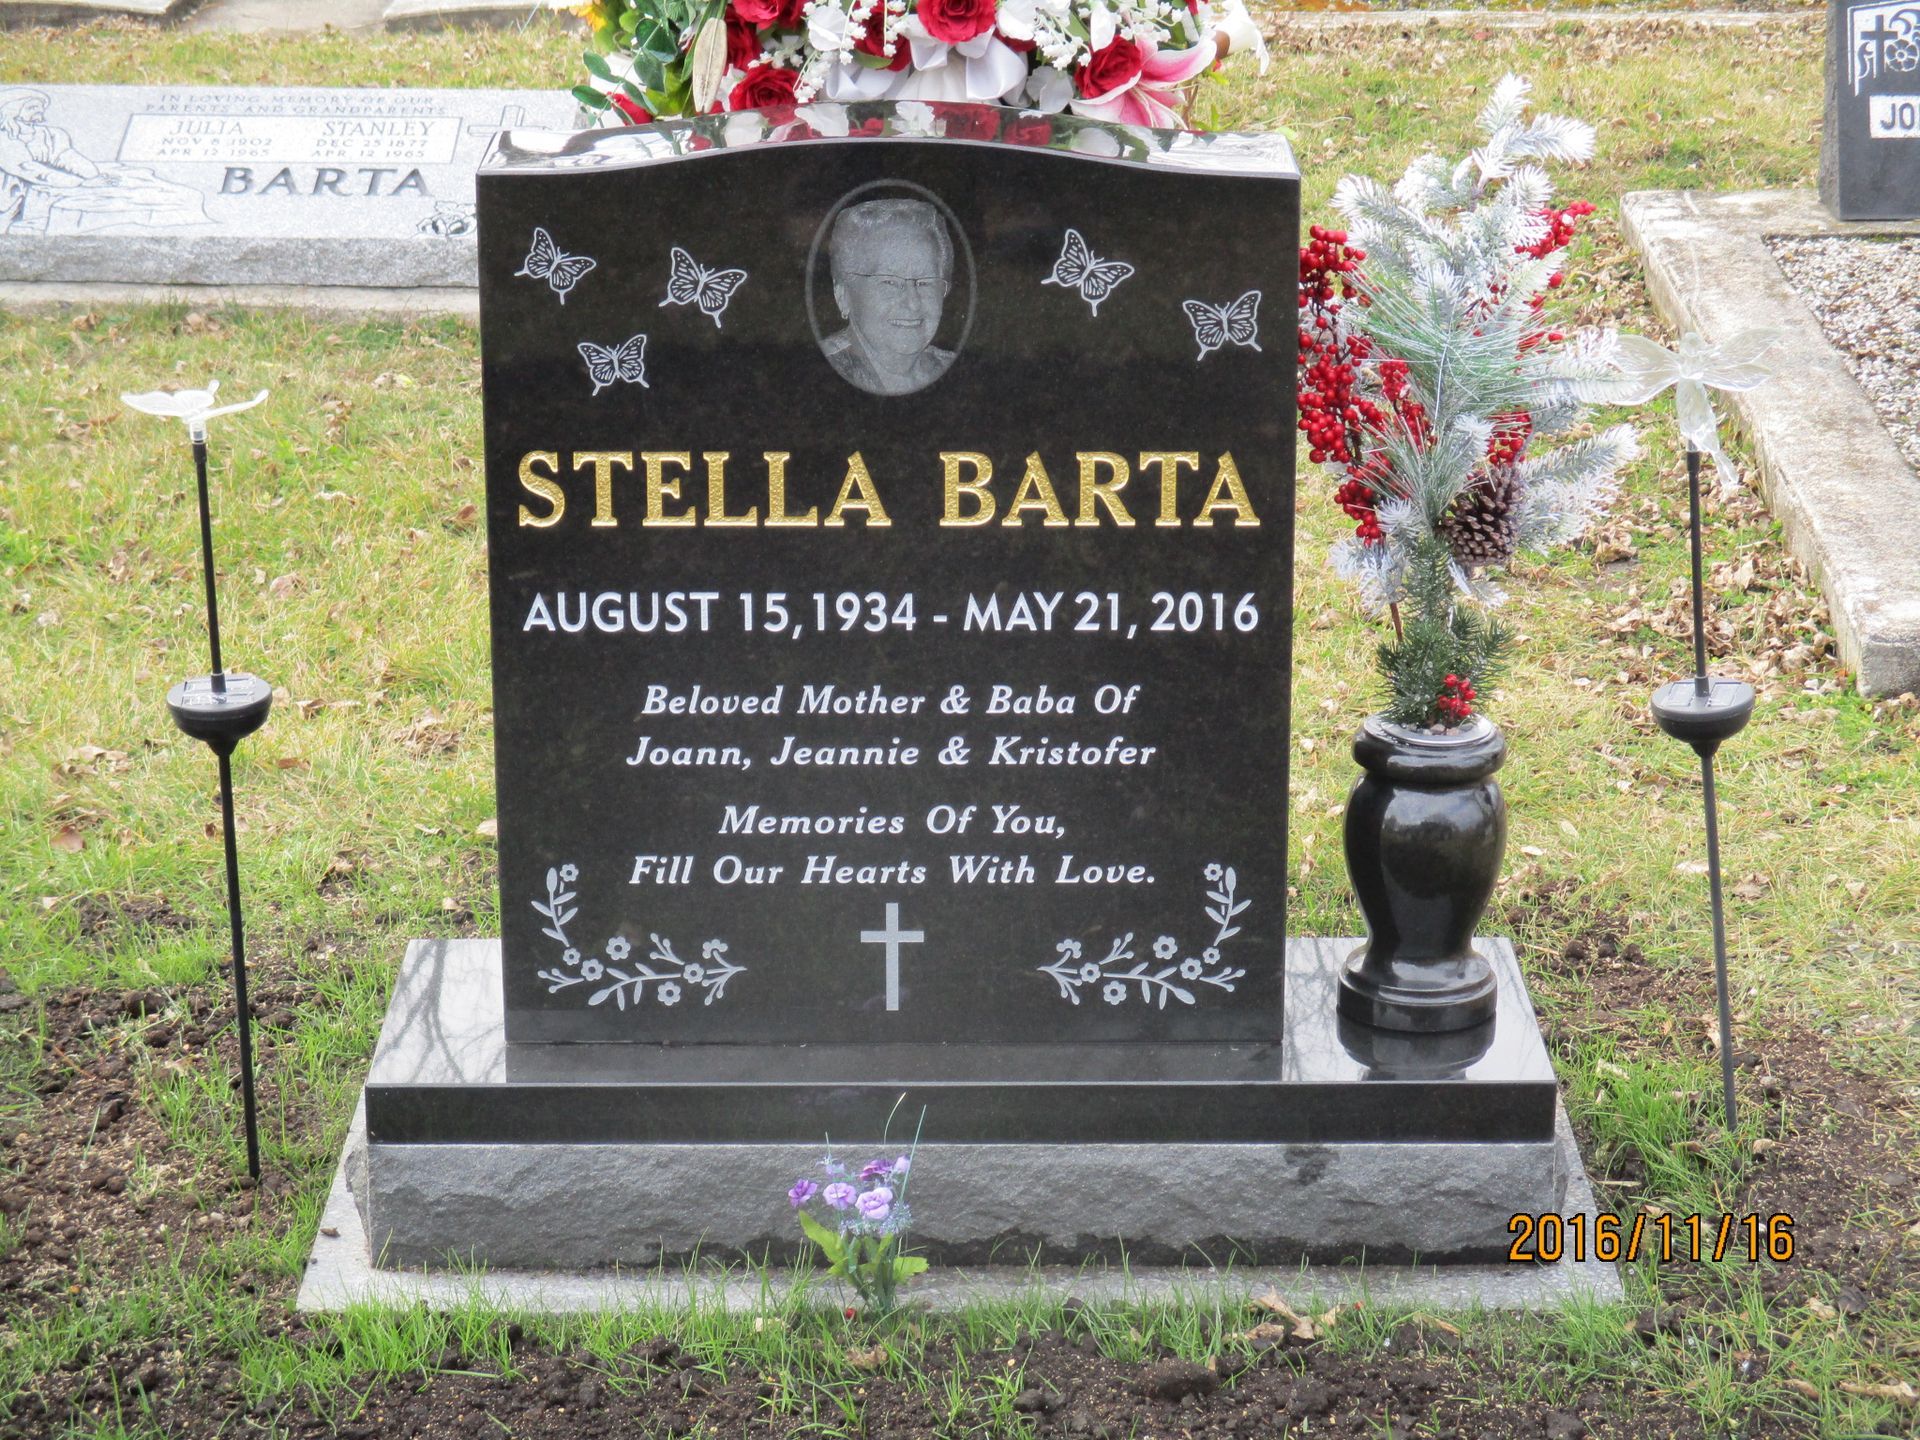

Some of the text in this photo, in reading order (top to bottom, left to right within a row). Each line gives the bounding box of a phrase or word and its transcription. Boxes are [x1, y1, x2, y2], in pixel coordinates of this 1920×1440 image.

[145, 104, 446, 115] PARENTS AND GRANDPARENTS
[160, 94, 434, 105] IN LOVING MEMORY OF OUR
[168, 120, 244, 135] JULIA
[1880, 102, 1920, 131] JO
[322, 121, 436, 137] STANLEY
[156, 148, 191, 156] APR
[161, 137, 202, 146] NOV
[316, 138, 429, 147] DEC 25 1877
[311, 150, 347, 158] APR
[217, 166, 436, 197] BARTA
[518, 450, 1261, 529] STELLA BARTA
[522, 591, 720, 633] AUGUST
[932, 614, 948, 624] -
[963, 591, 1065, 633] MAY
[1073, 591, 1138, 640] 21,
[1149, 591, 1260, 633] 2016
[640, 683, 1142, 715] Beloved Mother & Baba Of
[625, 735, 1157, 771] Joann, Jeannie & Kristofer
[717, 804, 1067, 840] Memories Of You,
[628, 854, 1156, 885] Fill Our Hearts With Love.
